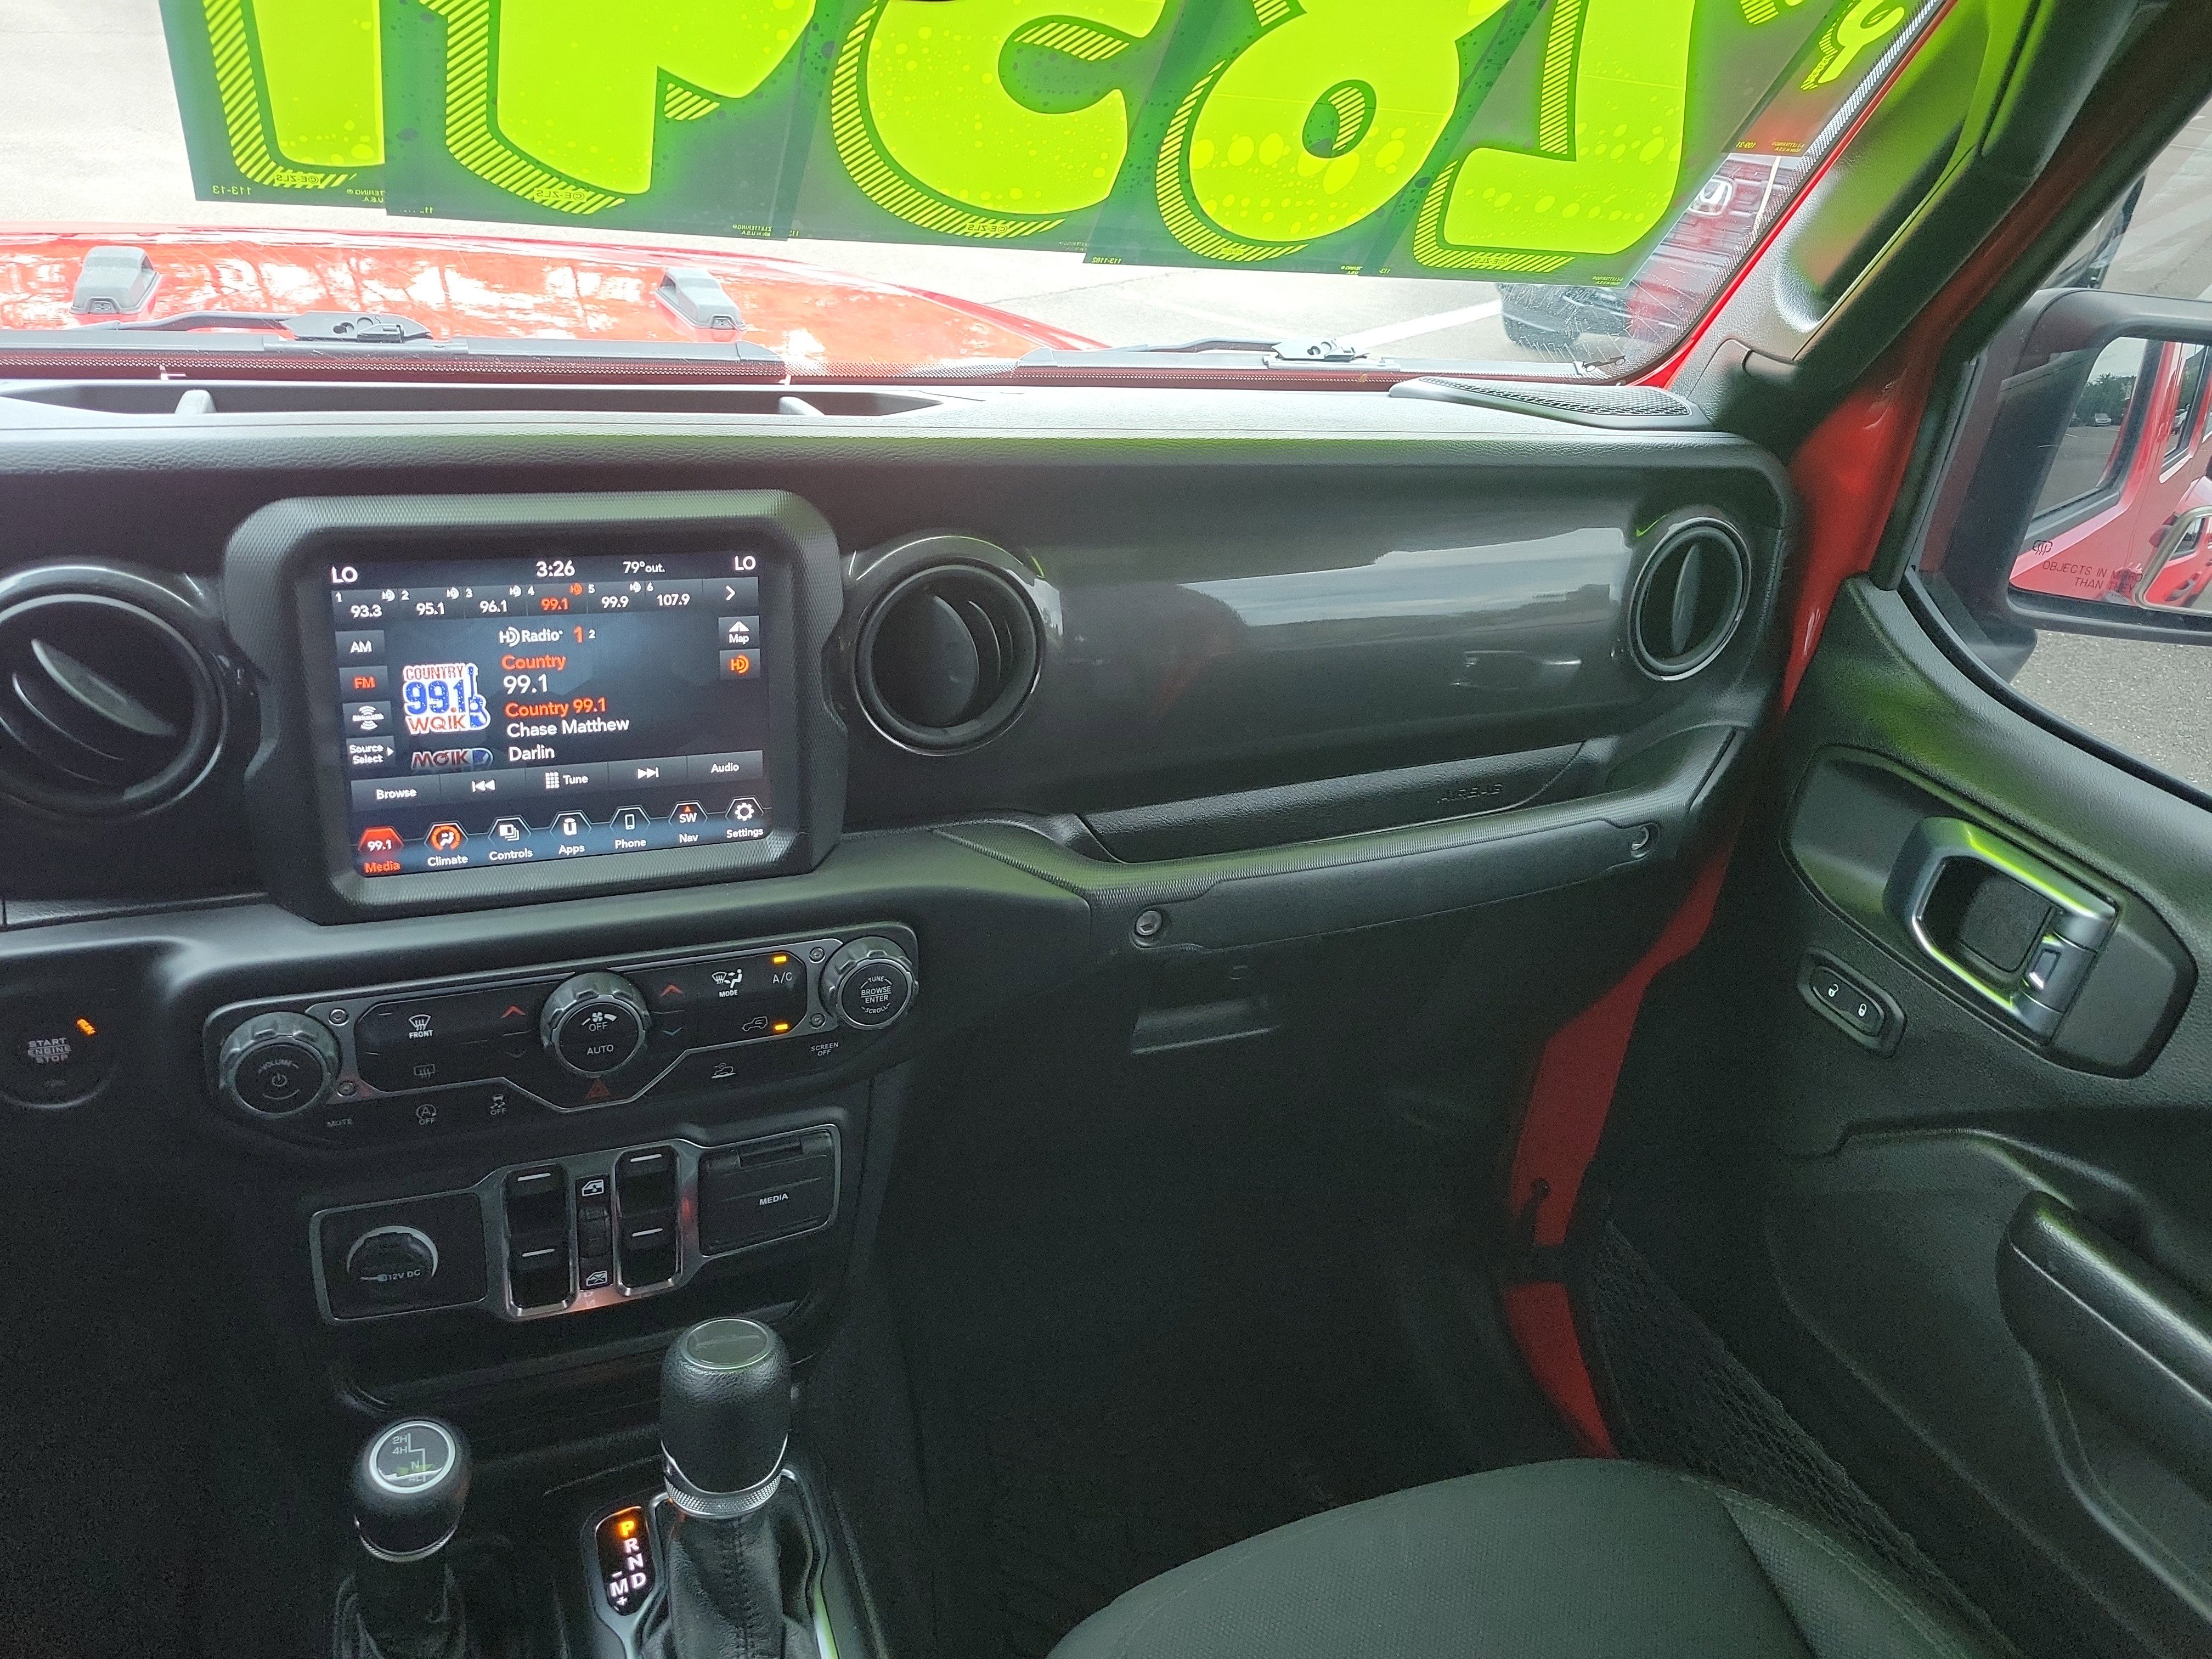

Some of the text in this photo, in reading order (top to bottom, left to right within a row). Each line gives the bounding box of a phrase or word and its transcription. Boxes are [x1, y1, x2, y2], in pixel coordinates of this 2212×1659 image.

[536, 560, 575, 577] 3:26
[735, 556, 756, 571] LO
[331, 566, 358, 583] LO
[2042, 561, 2092, 575] OBJECTS
[2096, 567, 2107, 578] IN
[646, 582, 654, 592] 6
[2075, 577, 2104, 589] THAN
[465, 588, 473, 598] 3
[527, 586, 535, 596] 4
[588, 584, 595, 594] 5
[336, 592, 342, 602] 1
[401, 590, 410, 601] 2
[657, 594, 690, 606] 107.9
[479, 600, 508, 613] 96.1
[541, 598, 568, 611] 99.1
[601, 596, 629, 608] 99.9
[351, 605, 382, 618] 93.3
[416, 602, 445, 615] 95.1
[574, 627, 583, 643] 1
[588, 629, 596, 639] 2
[729, 633, 749, 645] Map
[350, 640, 373, 653] AM
[501, 654, 567, 670] Country
[405, 665, 464, 680] COUNTRY
[354, 676, 375, 689] FM
[503, 674, 548, 694] 99.1
[405, 679, 466, 714] 99.1
[505, 697, 606, 718] Country 99.1
[408, 714, 466, 732] WQIK
[507, 717, 630, 737] Chase Matthew
[349, 744, 383, 754] Source
[509, 744, 555, 761] Darlin
[353, 754, 383, 764] Select
[711, 763, 740, 774] Audio
[563, 775, 588, 785] Tune
[376, 789, 417, 800] Browse
[679, 812, 697, 823] SW
[726, 827, 764, 838] Settings
[615, 839, 646, 849] Phone
[679, 834, 698, 843] Nav
[368, 839, 392, 851] 99.1
[558, 844, 585, 855] Apps
[489, 848, 533, 861] Controls
[427, 854, 469, 867] Climate
[365, 861, 401, 873] Media
[772, 972, 793, 984] A/C
[719, 989, 738, 998] MODE
[861, 985, 891, 996] BROWSE
[865, 995, 888, 1004] ENTER
[865, 1005, 888, 1014] SCROLL
[589, 1022, 608, 1031] OFF
[409, 1029, 433, 1039] FRONT
[29, 1037, 66, 1047] START
[811, 1042, 839, 1052] SCREEN
[586, 1044, 614, 1055] AUTO
[36, 1054, 68, 1063] STOP
[490, 1108, 506, 1116] OFF
[326, 1118, 353, 1127] MUTE
[419, 1117, 435, 1125] OFF
[759, 1193, 788, 1205] MEDIA
[407, 1269, 421, 1278] DC
[392, 1435, 407, 1444] 2H
[392, 1446, 408, 1454] 4H
[410, 1460, 420, 1470] N
[620, 1520, 634, 1537] P
[624, 1537, 639, 1553] R
[628, 1553, 644, 1571] N
[631, 1572, 646, 1589] D
[610, 1578, 629, 1597] M
